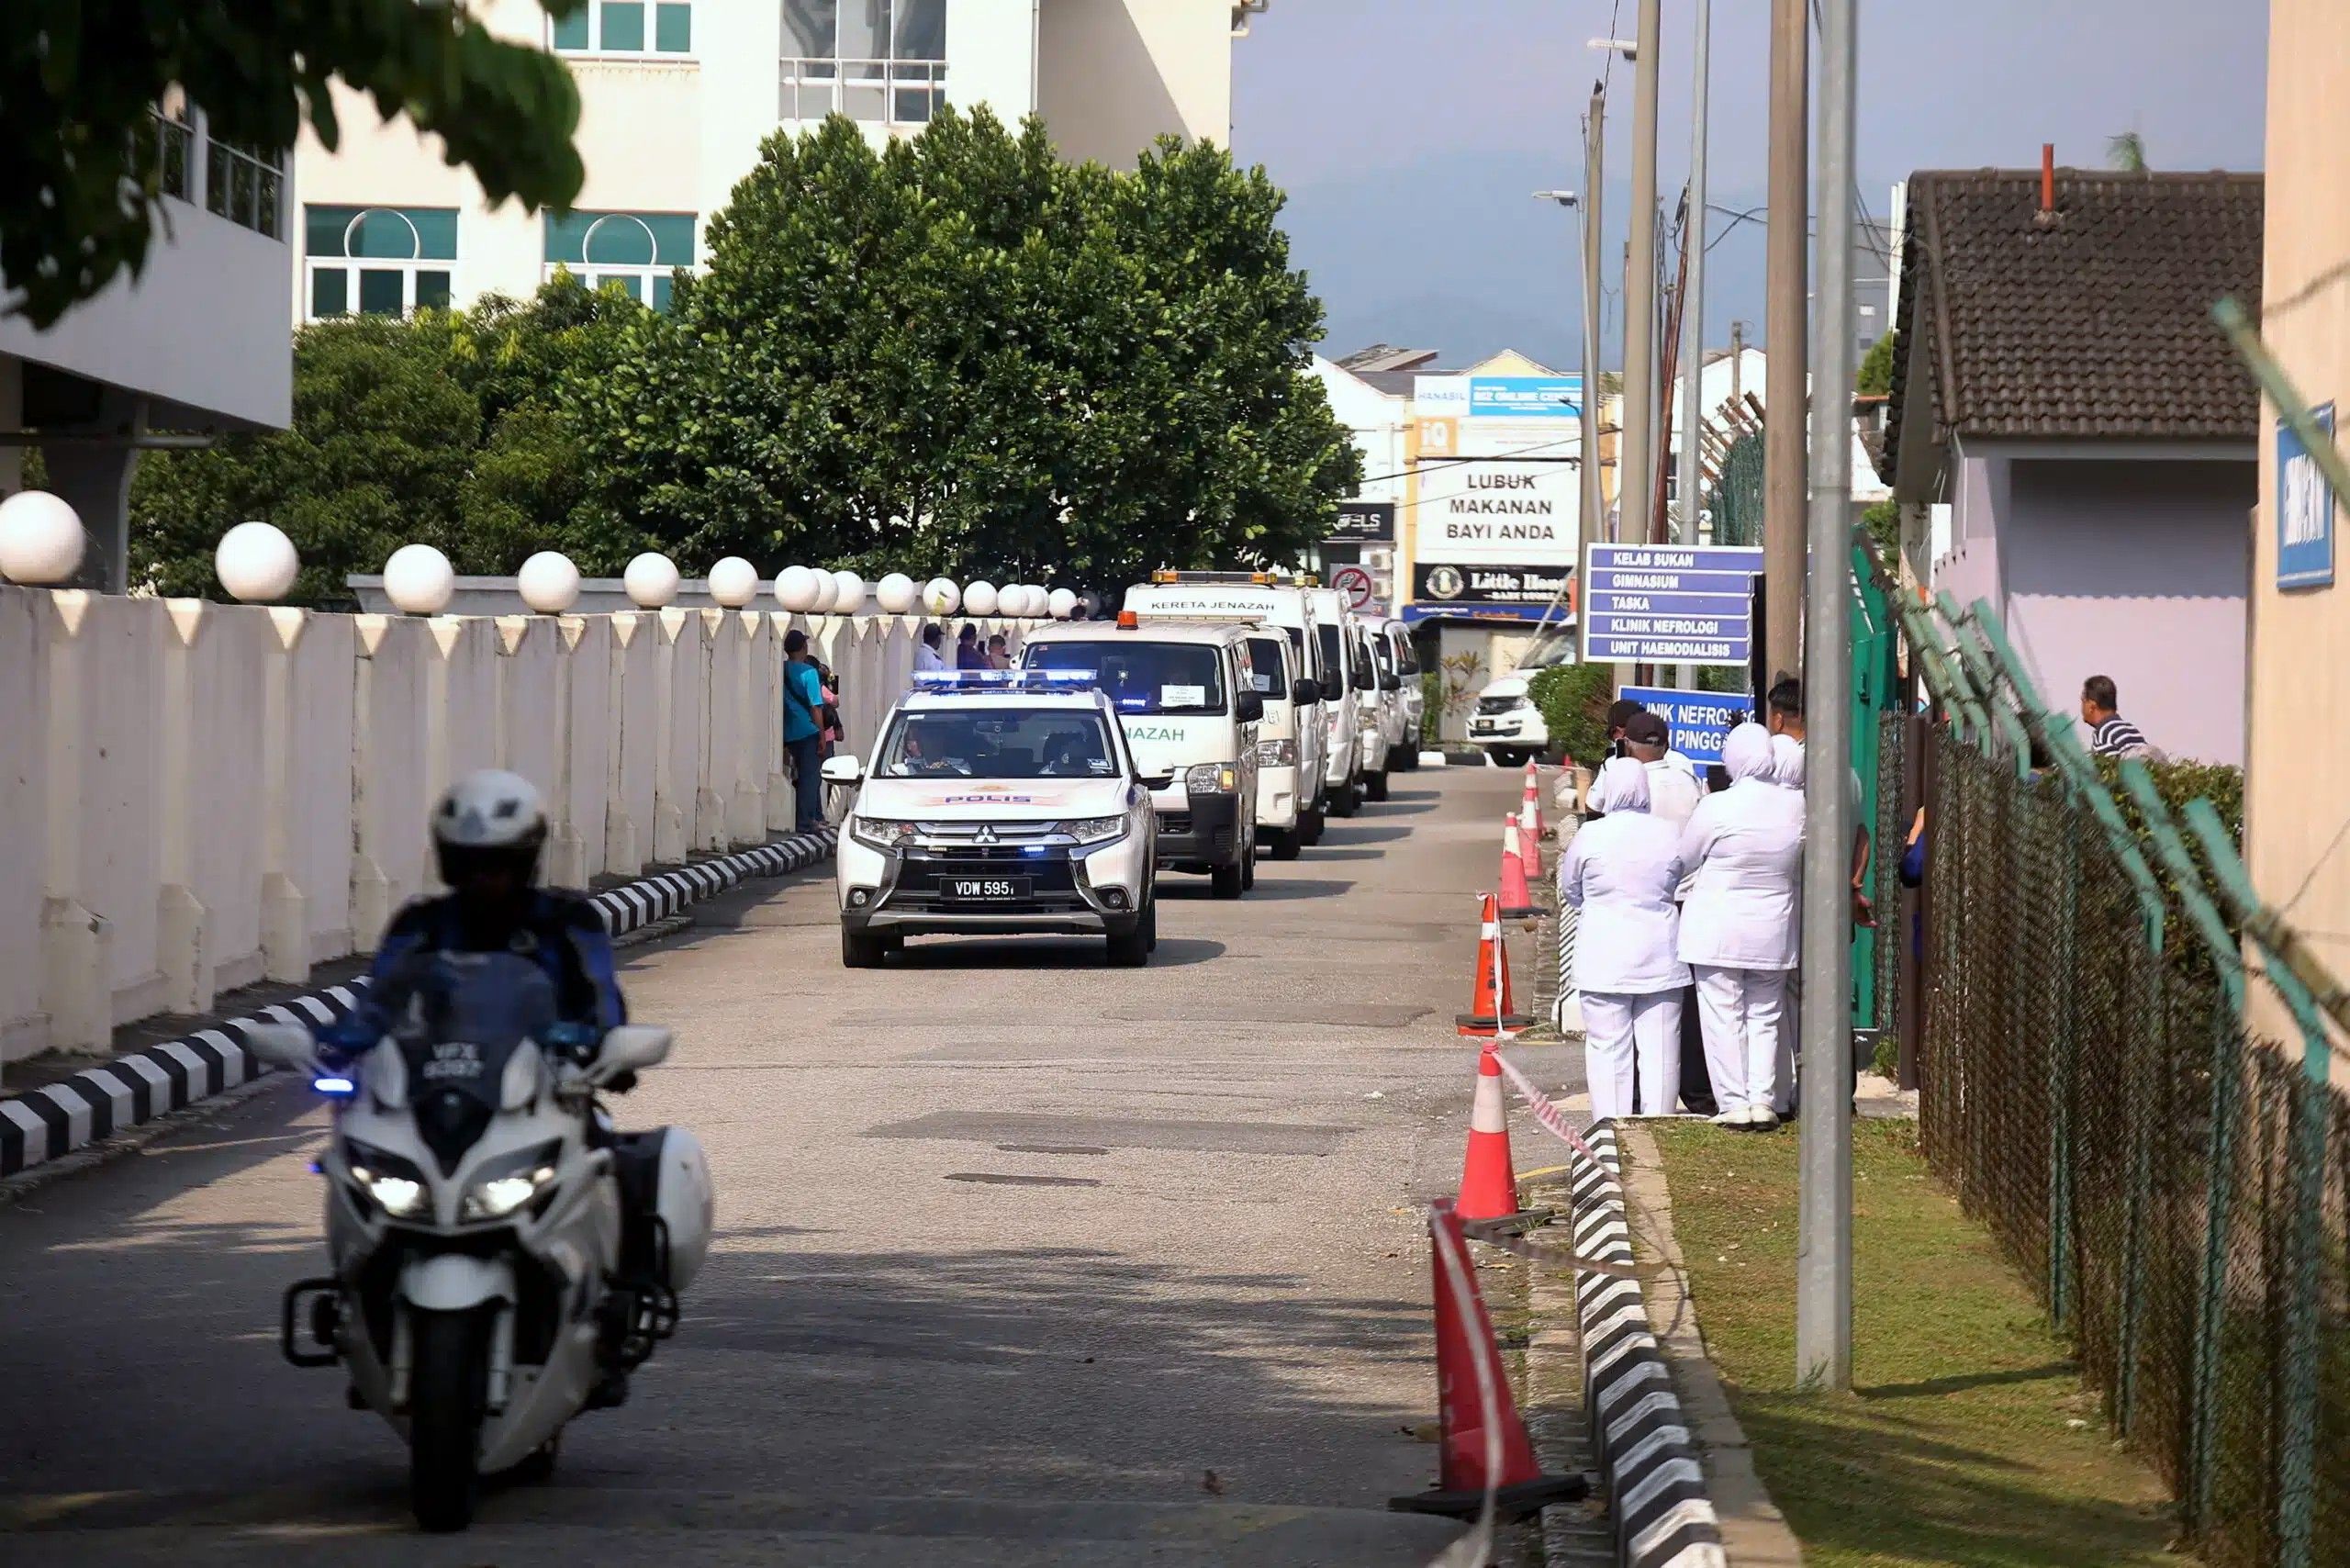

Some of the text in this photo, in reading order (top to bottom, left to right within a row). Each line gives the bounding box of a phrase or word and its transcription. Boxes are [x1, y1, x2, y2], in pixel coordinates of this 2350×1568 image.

[1467, 474, 1537, 489] LUBUK
[1449, 498, 1552, 515] MAKANAN
[1446, 523, 1555, 540] BAYI ANDA
[1613, 552, 1695, 567] KELAB SUKAN
[1470, 572, 1520, 591] Little
[1612, 574, 1679, 589] GIMNASIUM
[1151, 601, 1275, 610] KERETA JENAZAH
[1611, 596, 1651, 611] TASKA
[1610, 618, 1718, 634] KLINIK NEFROLOGI
[1610, 640, 1731, 657] UNIT HAEMODIALISIS
[946, 795, 1031, 803] POLIS
[955, 881, 981, 896] VDW
